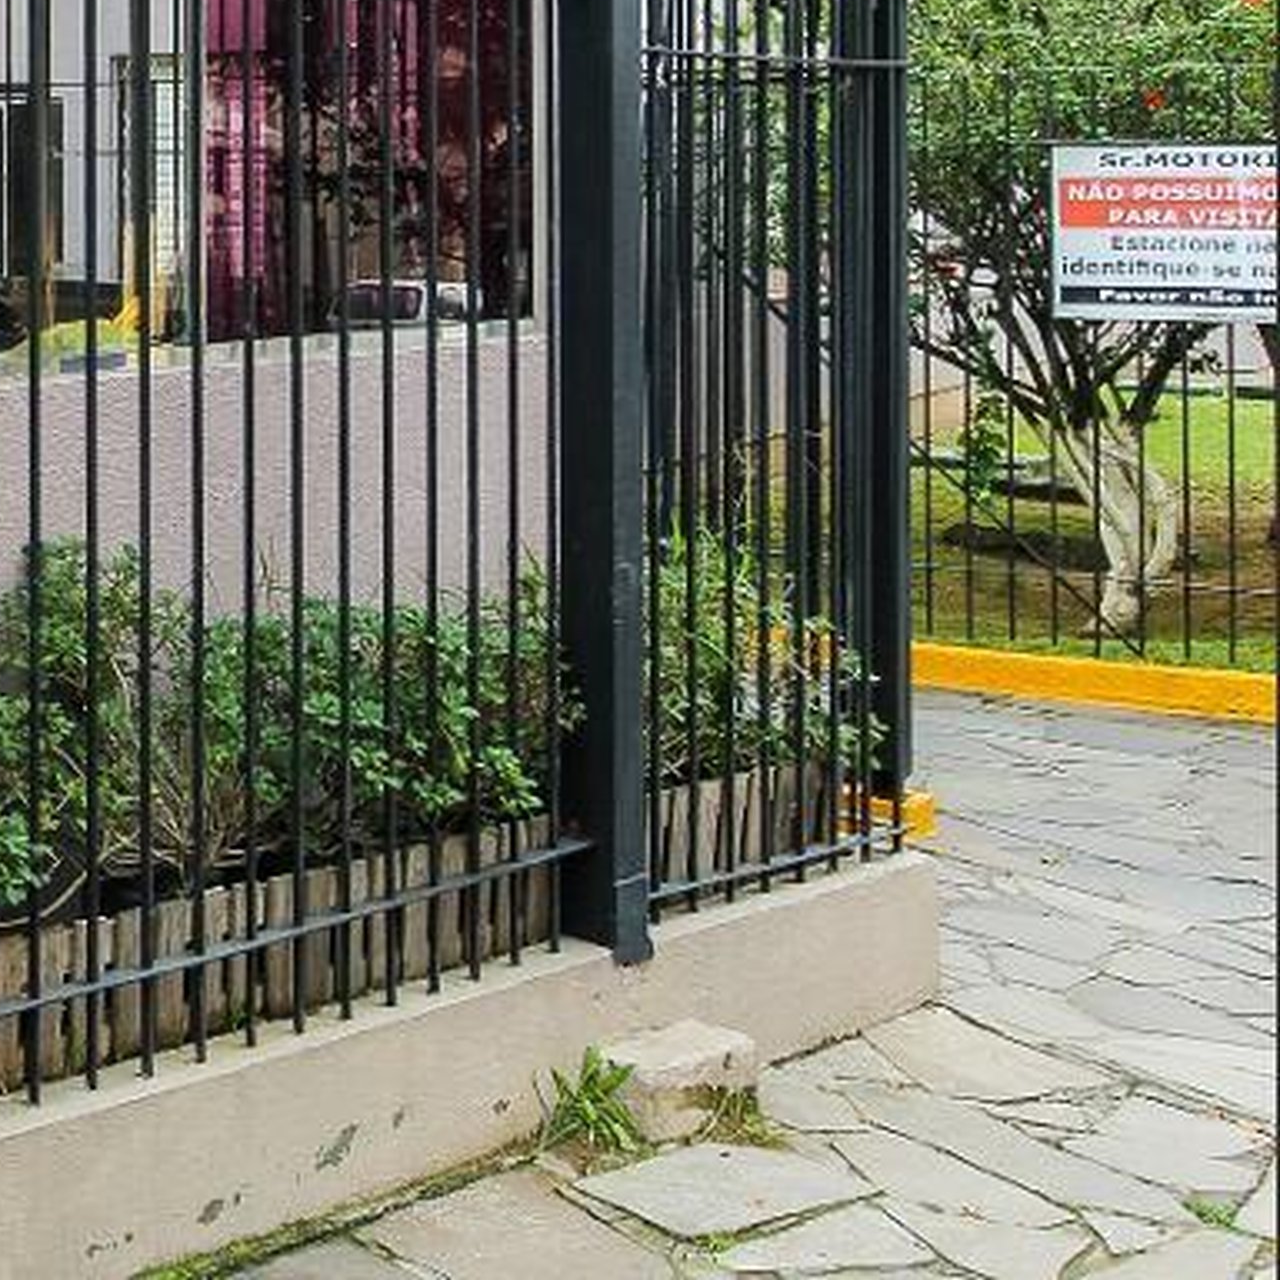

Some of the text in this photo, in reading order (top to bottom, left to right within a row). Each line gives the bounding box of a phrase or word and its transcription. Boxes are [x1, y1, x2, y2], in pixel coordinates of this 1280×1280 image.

[1067, 180, 1124, 201] NÃO
[1108, 208, 1176, 226] PARA
[1111, 235, 1236, 254] Estacione
[1099, 289, 1181, 302] Favor
